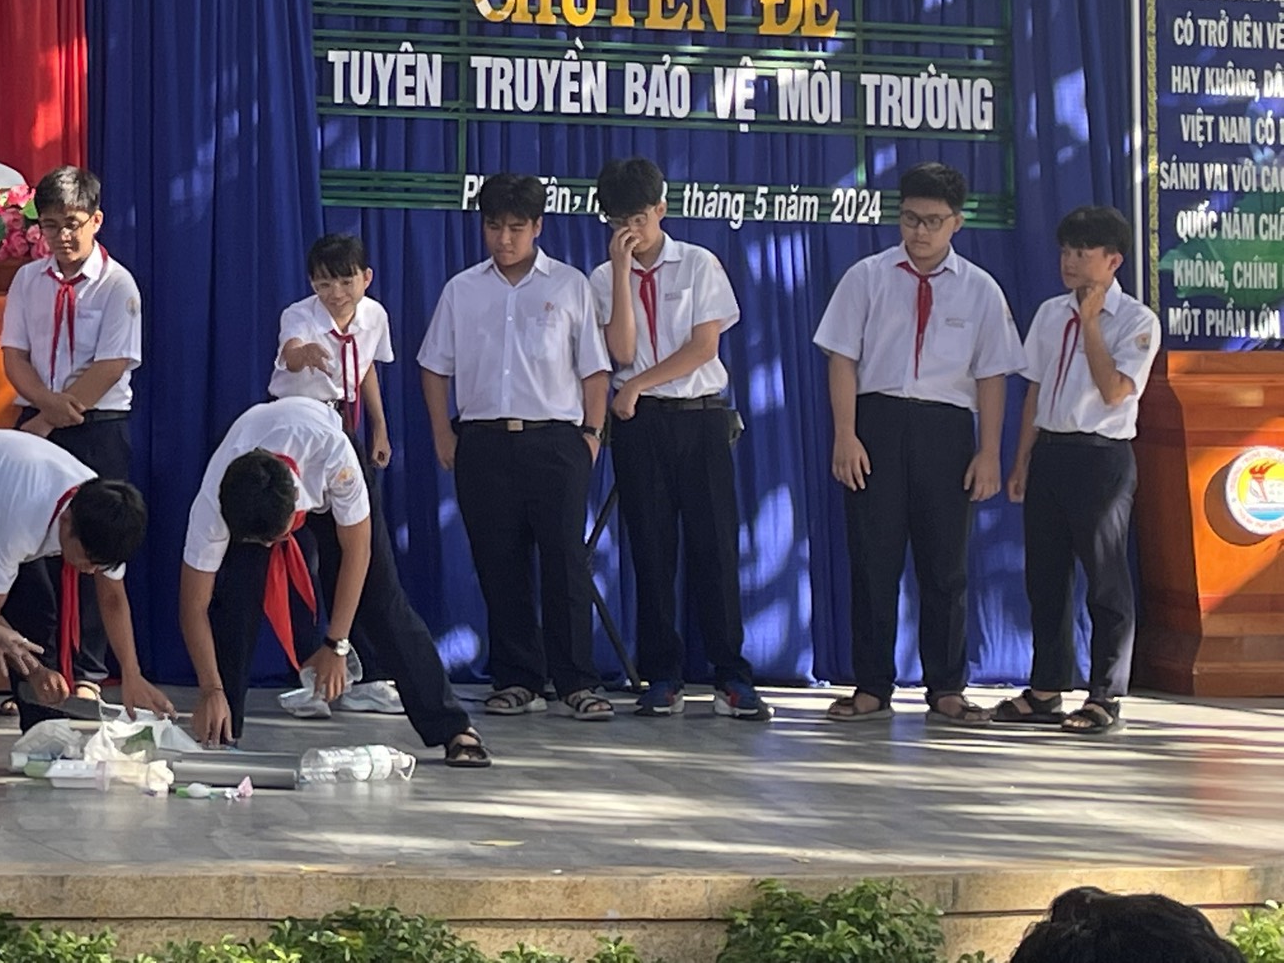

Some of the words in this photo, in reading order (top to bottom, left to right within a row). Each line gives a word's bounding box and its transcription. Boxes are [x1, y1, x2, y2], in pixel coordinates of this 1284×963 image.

[1174, 10, 1195, 46] CÓ
[1198, 9, 1229, 48] TRỞ
[1232, 14, 1263, 49] NÊN
[326, 40, 443, 108] TUYÊN
[469, 36, 608, 118] TRUYỀN
[623, 53, 692, 120] BẢO
[713, 55, 757, 133] VỆ
[776, 58, 842, 125] MÔI
[858, 63, 995, 132] TRƯỜNG
[1171, 65, 1201, 94] HAY
[1204, 60, 1260, 103] KHÔNG,
[1263, 62, 1284, 98] DÂ
[1180, 107, 1214, 148] VIỆT
[1218, 116, 1251, 144] NAM
[1255, 109, 1275, 146] CÓ
[1159, 154, 1200, 191] SÁNH
[1203, 162, 1228, 192] VAI
[1231, 157, 1257, 192] VỚI
[682, 181, 745, 231] tháng
[753, 186, 769, 220] 5
[773, 184, 819, 224] năm
[829, 187, 883, 226] 2024
[1176, 200, 1218, 244] QUỐC
[1174, 252, 1229, 294] KHÔNG,
[1233, 255, 1278, 289] CHÍNH
[1169, 300, 1202, 343] MỘT
[1206, 297, 1247, 338] PHẦN
[1249, 303, 1281, 339] LỚN
